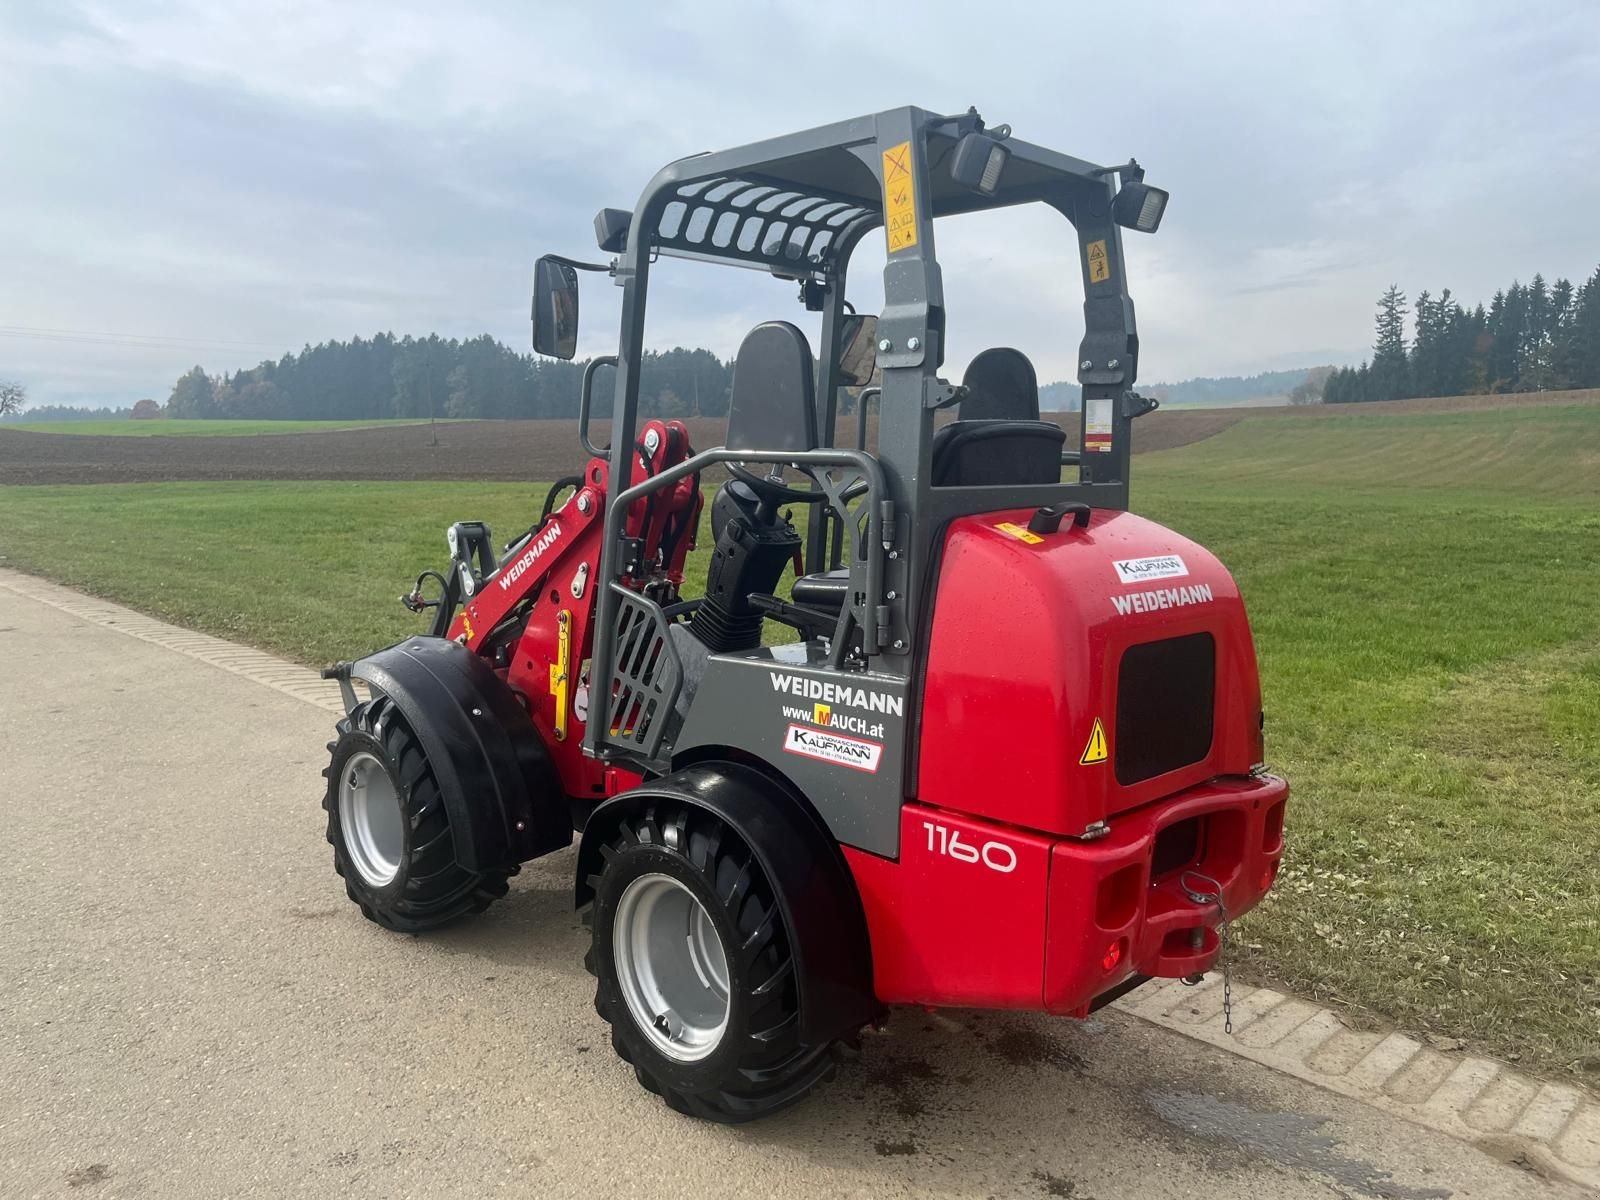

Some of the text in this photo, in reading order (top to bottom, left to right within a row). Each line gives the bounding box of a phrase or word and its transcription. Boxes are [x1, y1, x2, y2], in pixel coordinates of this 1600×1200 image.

[499, 522, 562, 591] WEIDEMANN
[1110, 584, 1213, 616] WEIDEMANN
[770, 672, 903, 717] WEIDEMANN
[782, 705, 885, 738] www.MAUCH.at
[794, 730, 871, 760] KAUFMANN
[923, 821, 1017, 873] 1160
